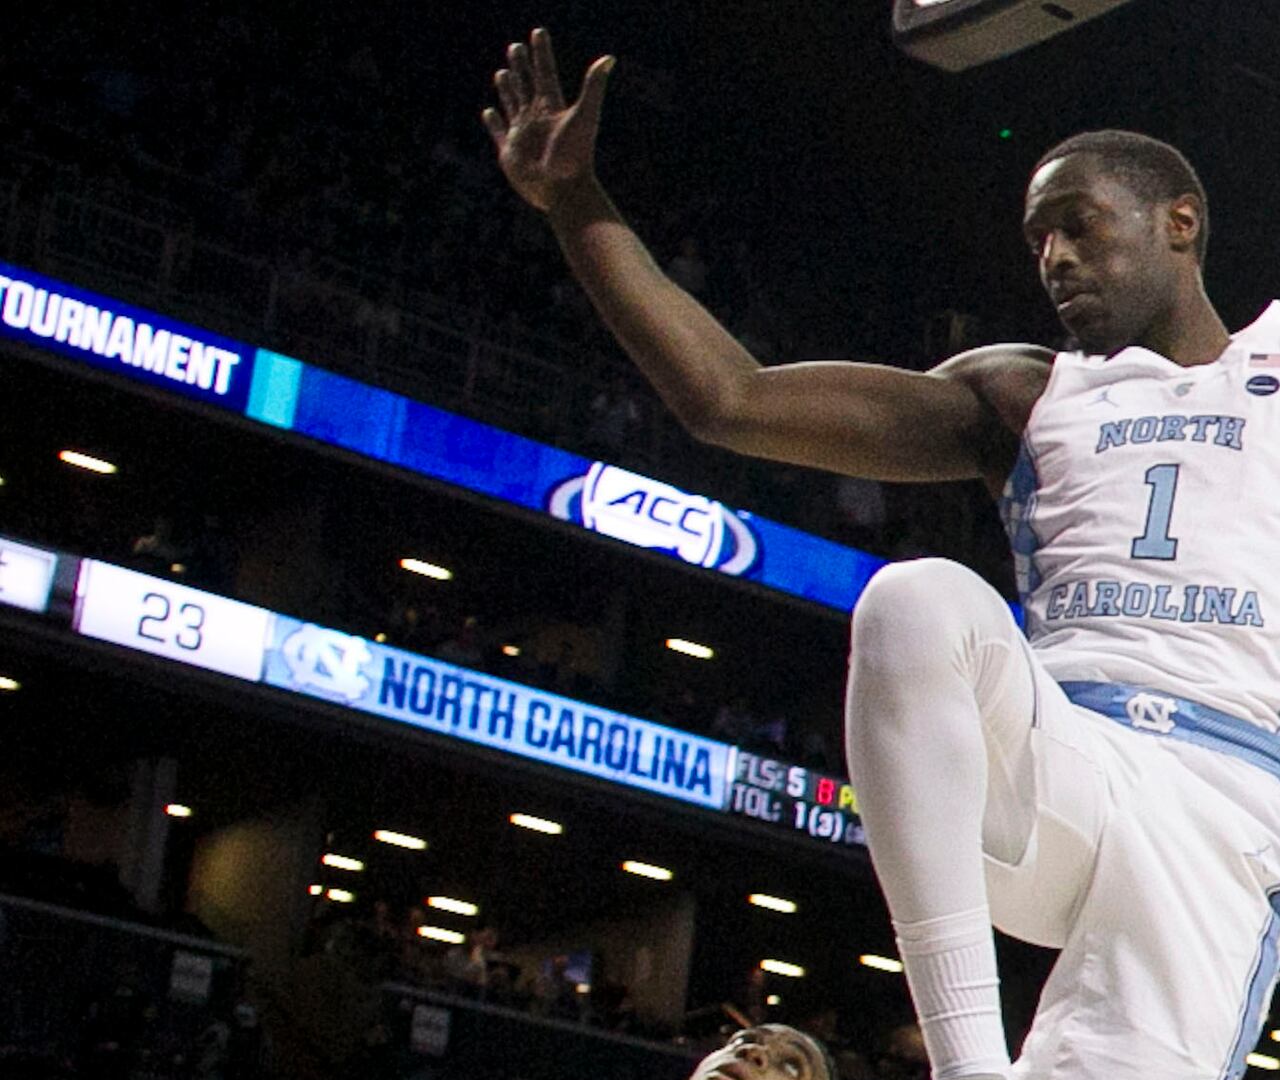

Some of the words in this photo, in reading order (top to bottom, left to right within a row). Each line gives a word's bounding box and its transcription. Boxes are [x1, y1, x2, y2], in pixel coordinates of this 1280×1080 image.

[1095, 414, 1247, 453] NORTH
[608, 489, 710, 538] ACC
[1130, 463, 1181, 561] 1
[137, 592, 206, 651] 23
[1045, 581, 1265, 628] CAROLINA
[380, 656, 516, 740] NORTH
[524, 699, 713, 797] CAROLINA
